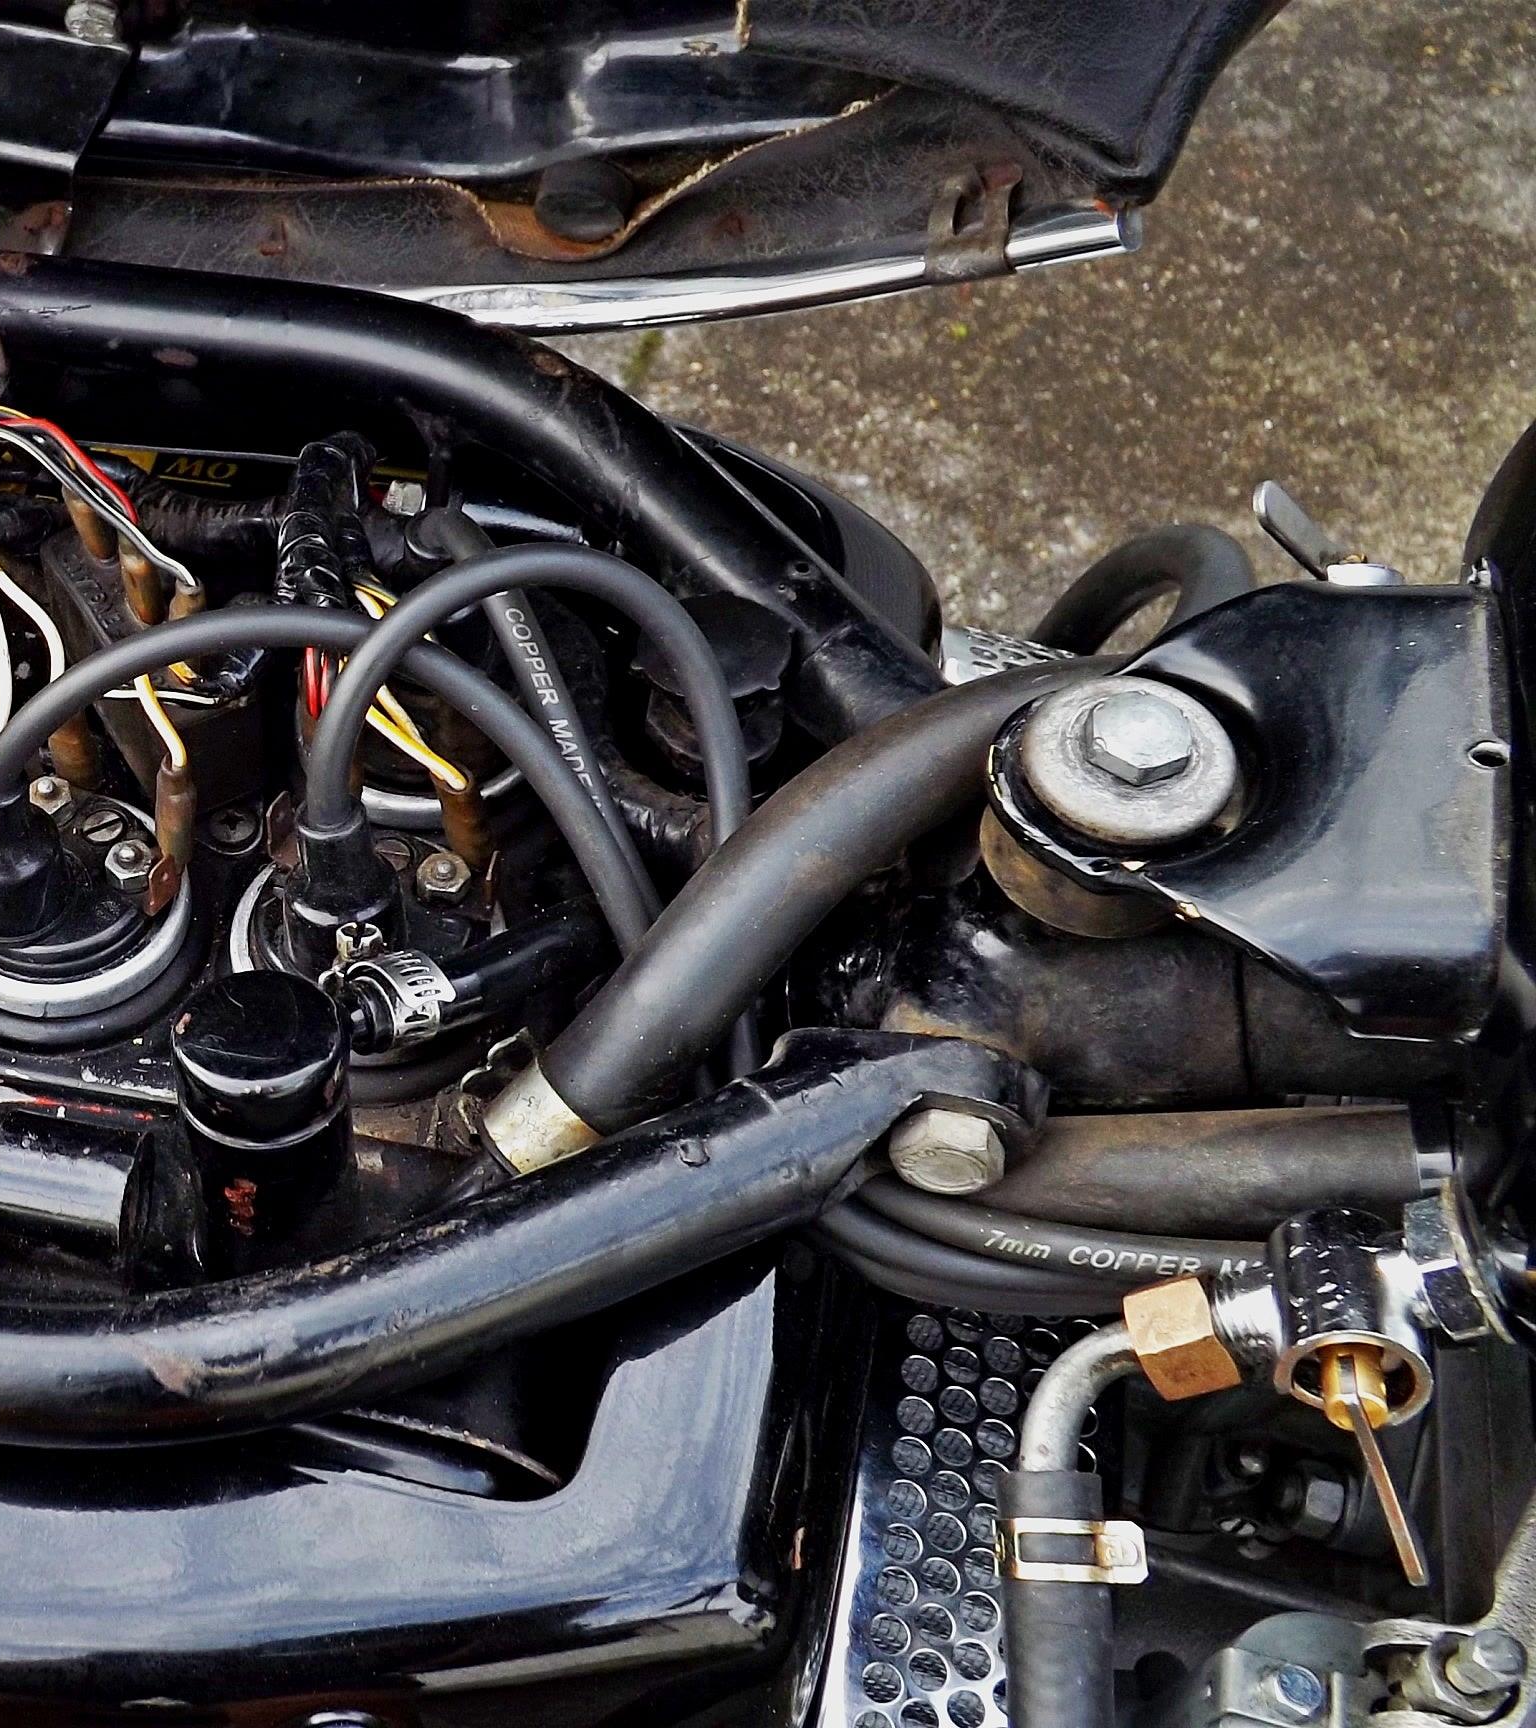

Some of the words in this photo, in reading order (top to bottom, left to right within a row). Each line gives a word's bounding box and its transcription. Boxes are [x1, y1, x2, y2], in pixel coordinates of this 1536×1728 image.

[504, 607, 560, 707] COPPER
[983, 1229, 1052, 1260] 7mm
[1067, 1245, 1203, 1276] COPPER
